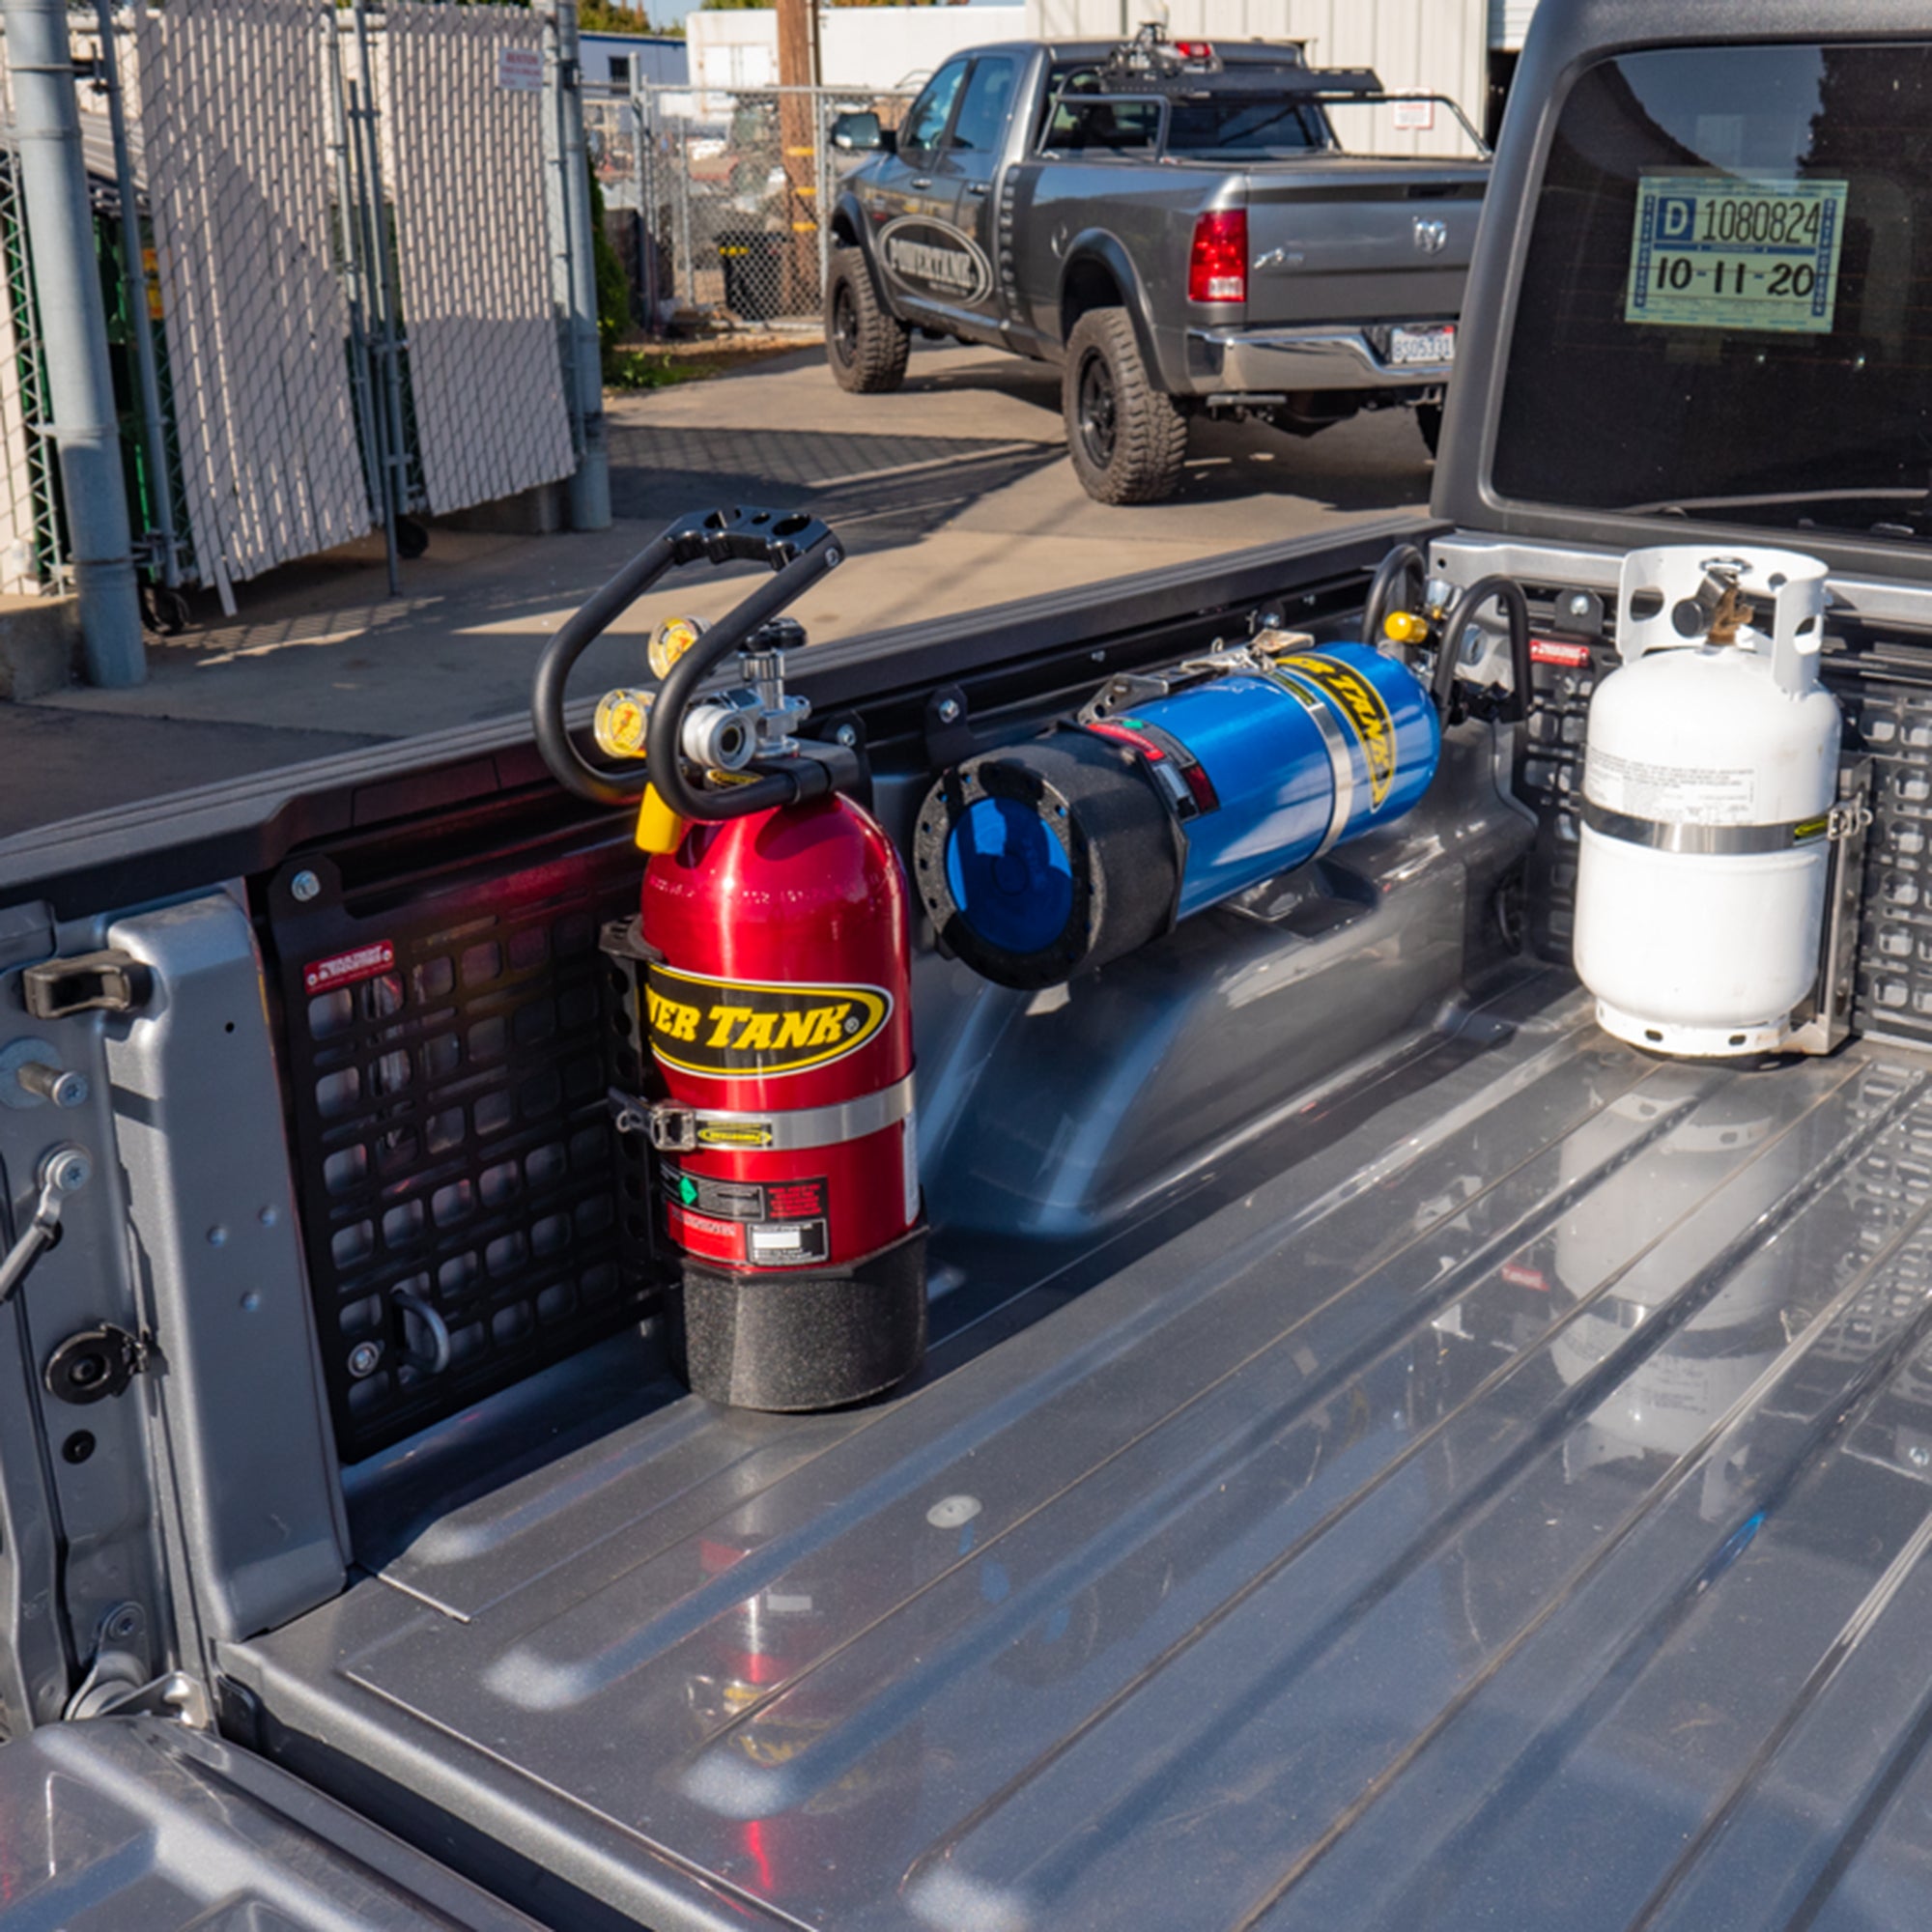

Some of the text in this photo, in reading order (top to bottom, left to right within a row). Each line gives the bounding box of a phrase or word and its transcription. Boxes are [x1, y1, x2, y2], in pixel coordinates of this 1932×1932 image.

[1663, 199, 1822, 244] D 1080824
[705, 1003, 852, 1050] TANK
